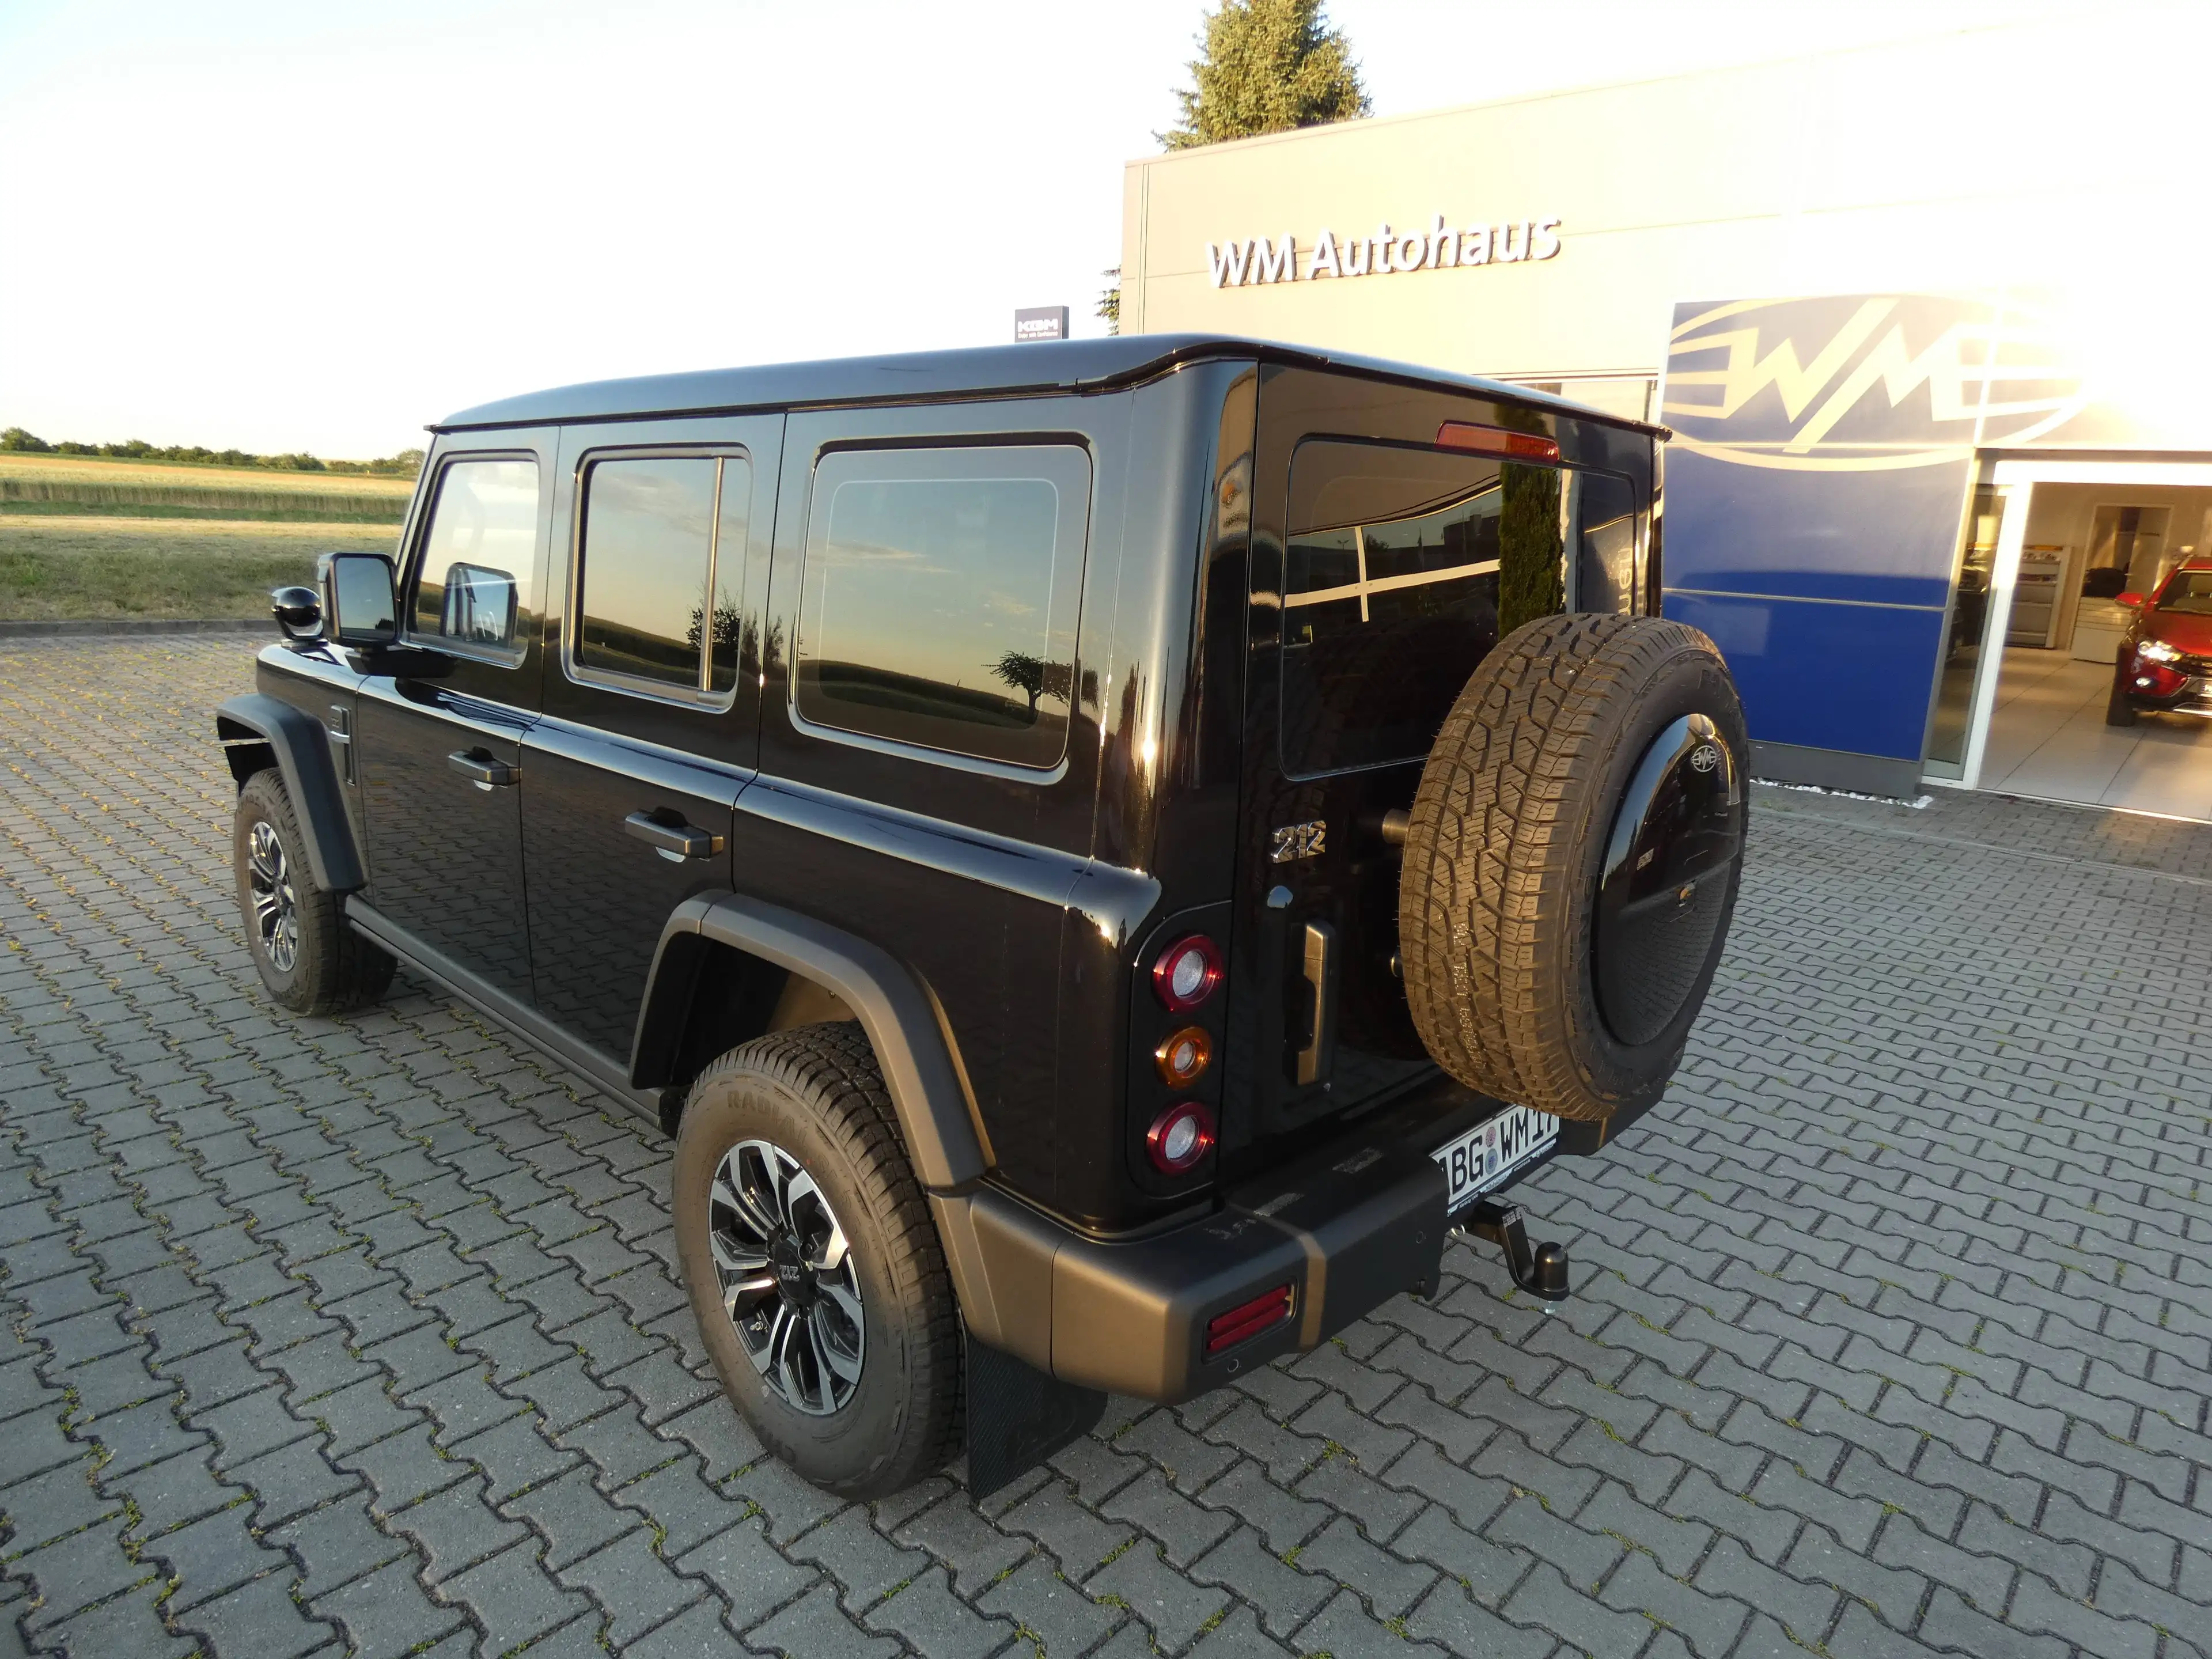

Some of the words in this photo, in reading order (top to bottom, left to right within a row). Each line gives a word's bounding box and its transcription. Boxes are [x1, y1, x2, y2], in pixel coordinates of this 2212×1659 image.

[1207, 234, 1298, 288] WM
[1306, 211, 1562, 280] Autohaus
[1272, 820, 1326, 863] 212
